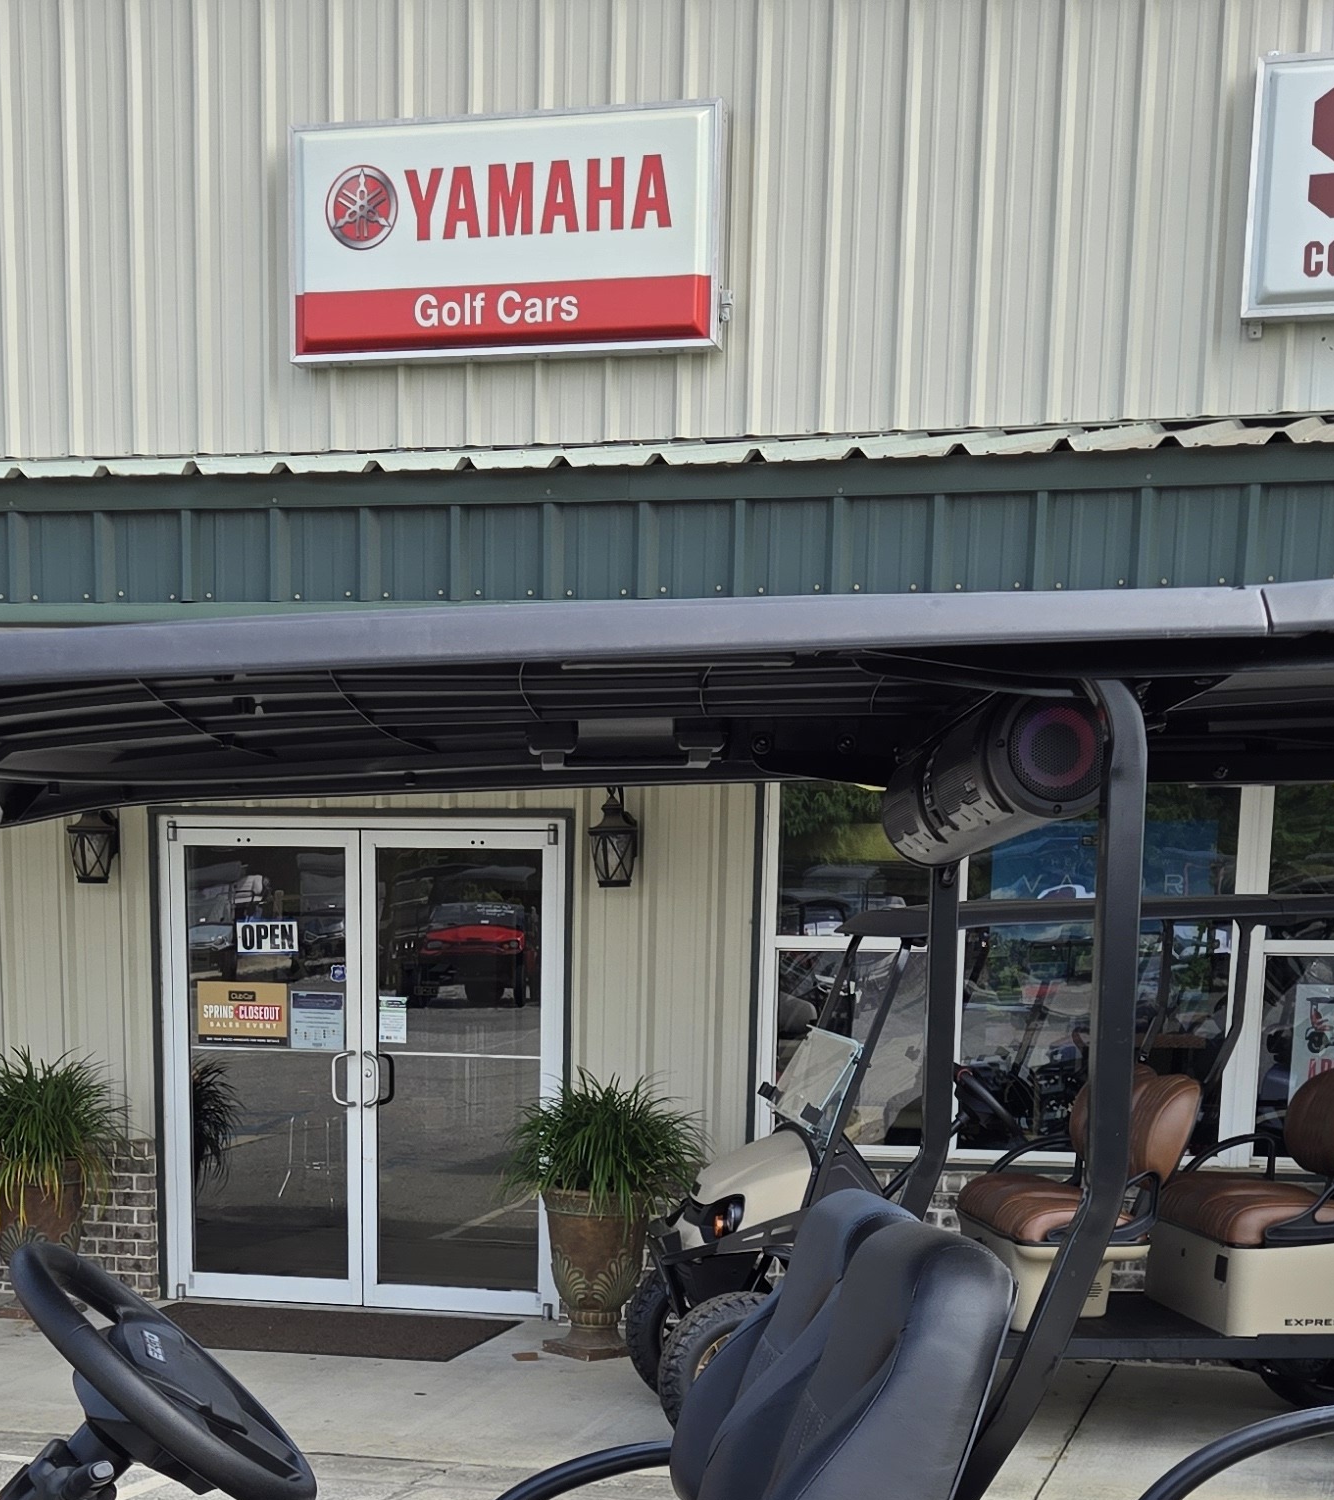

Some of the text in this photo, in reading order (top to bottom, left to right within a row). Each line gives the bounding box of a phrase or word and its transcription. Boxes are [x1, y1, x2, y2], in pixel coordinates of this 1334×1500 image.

[406, 153, 673, 240] YAMAHA
[414, 288, 580, 327] Golf Cars
[241, 924, 295, 951] OPEN
[203, 1004, 281, 1021] SPRING CLOSEOUT
[246, 1022, 278, 1030] EVENT
